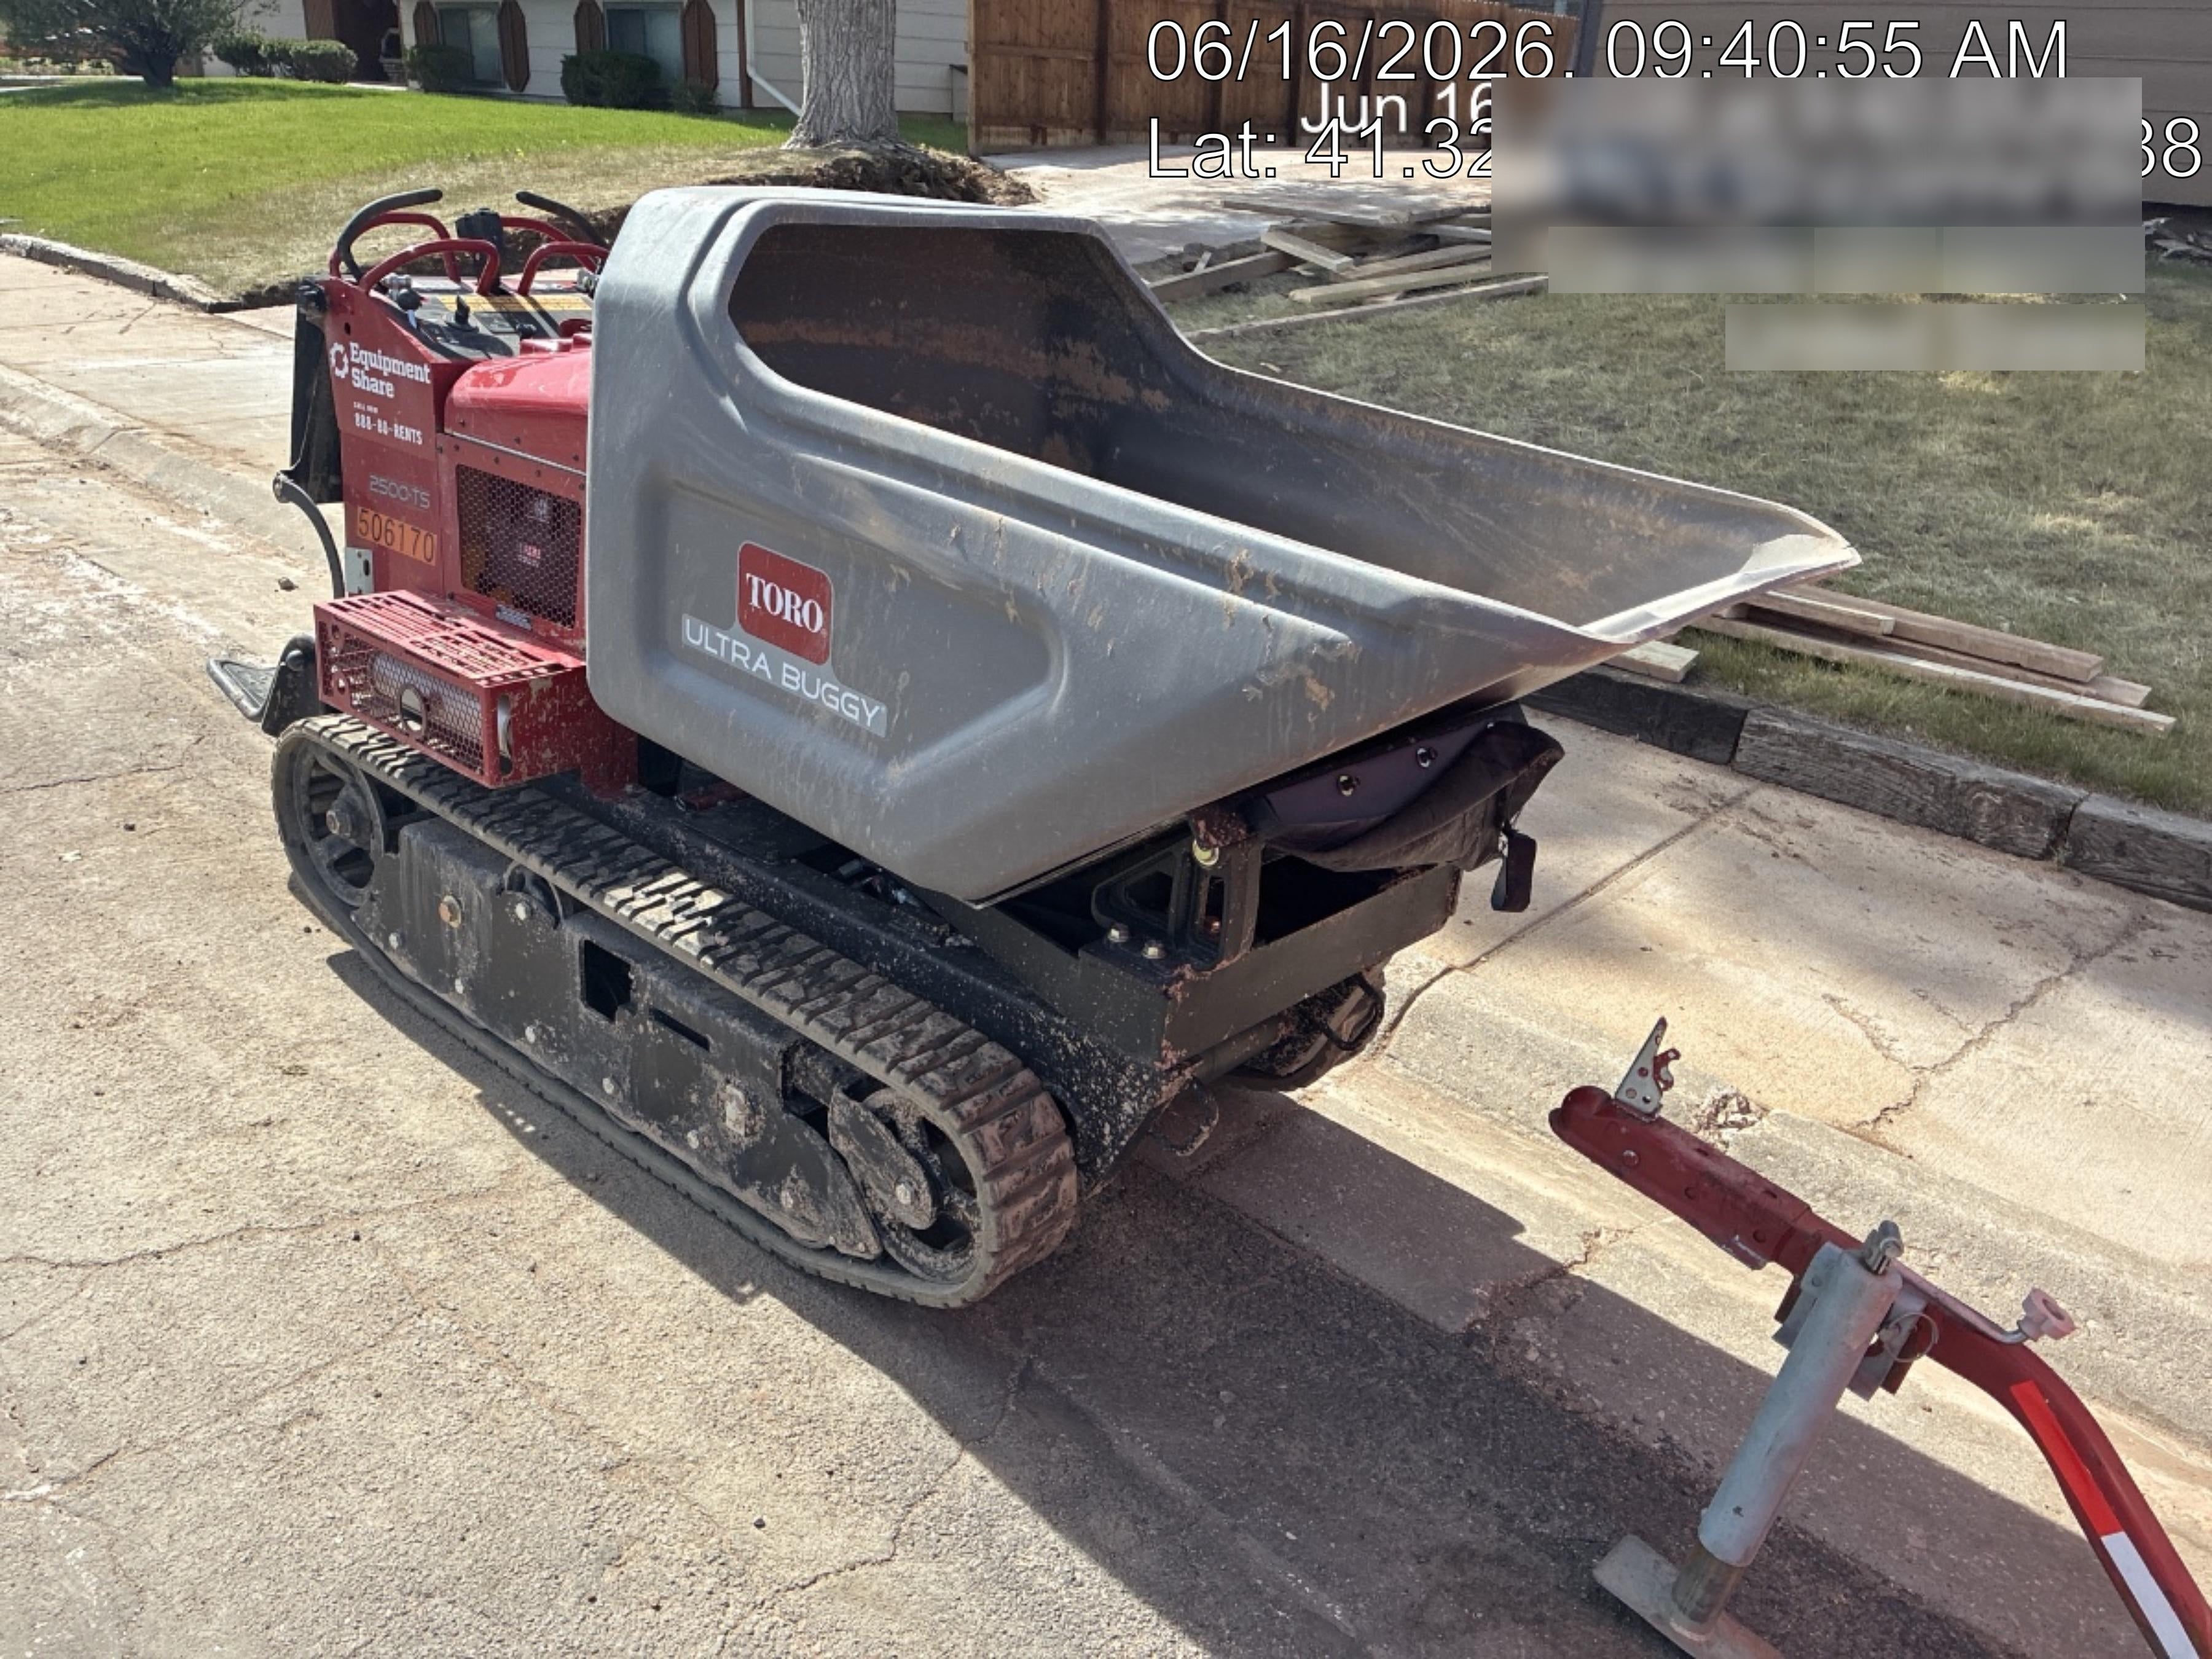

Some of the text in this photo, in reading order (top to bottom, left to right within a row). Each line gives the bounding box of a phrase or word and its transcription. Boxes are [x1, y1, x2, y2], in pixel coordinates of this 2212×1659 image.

[350, 342, 431, 384] Equipment
[351, 367, 394, 398] Share
[359, 508, 434, 563] 506170
[746, 573, 823, 633] TORO
[685, 619, 880, 728] ULTRA BUGGY
